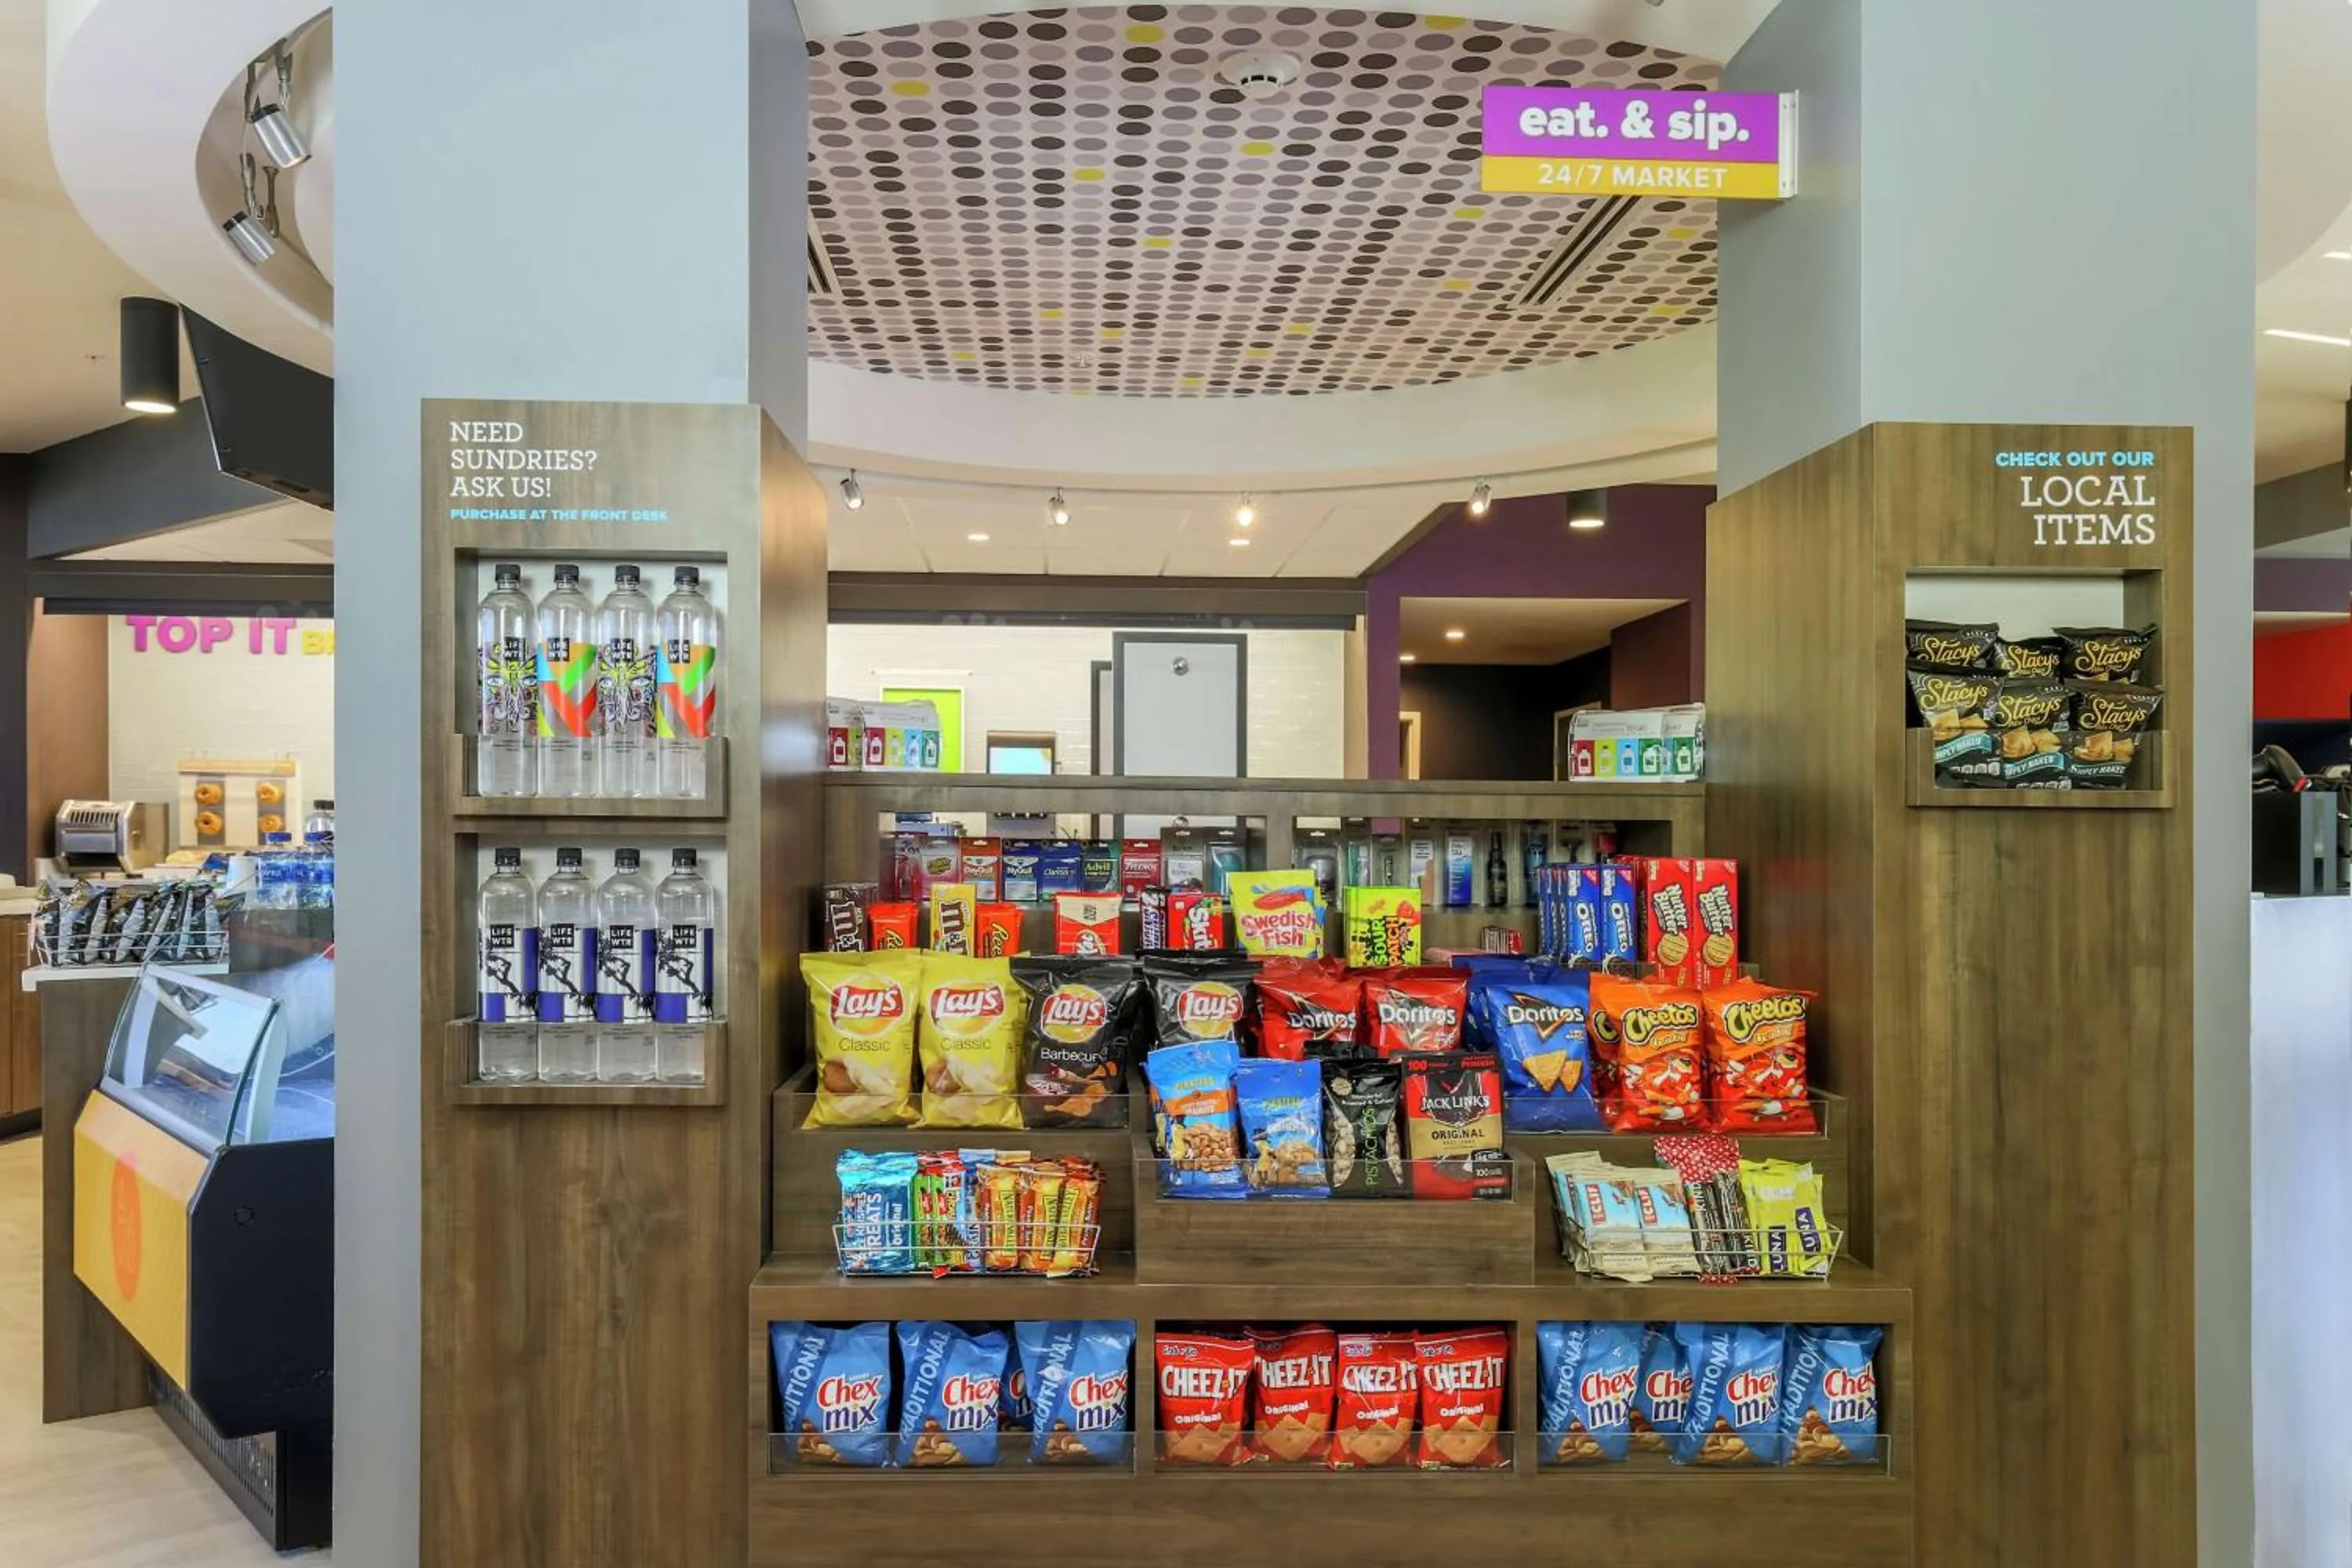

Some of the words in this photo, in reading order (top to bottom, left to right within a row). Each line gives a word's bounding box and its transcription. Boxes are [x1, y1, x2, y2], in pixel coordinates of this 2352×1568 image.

[1519, 101, 1609, 138] eat.
[1621, 100, 1655, 140] &
[1668, 100, 1750, 150] sip.
[1537, 163, 1603, 185] 24/7
[1612, 165, 1728, 189] MARKET
[449, 421, 524, 443] NEED
[449, 449, 598, 471] SUNDRIES?
[1995, 452, 2062, 467] CHECK
[2066, 452, 2107, 467] OUT
[2111, 452, 2155, 466] OUR
[449, 476, 505, 498] ASK
[510, 476, 552, 498] US!
[2020, 474, 2156, 507] LOCAL
[449, 509, 528, 521] PURCHASE
[529, 510, 547, 521] AT
[551, 510, 578, 521] THE
[581, 510, 628, 521] FRONT
[631, 510, 669, 522] DESK
[2033, 513, 2156, 545] ITEMS
[125, 615, 234, 654] TOP
[249, 616, 297, 655] IT
[2001, 644, 2060, 674] Stacy's
[2075, 641, 2143, 672] Stacy's
[1920, 677, 1989, 711] Stacy's
[1996, 693, 2061, 728] Stacy's
[2079, 695, 2147, 731] Stacy's
[1085, 862, 1111, 871] Advil
[1653, 891, 1678, 935] Butter
[1666, 884, 1688, 929] Nutter
[1699, 892, 1724, 935] Butter
[1711, 884, 1733, 931] Nutter
[492, 927, 512, 936] LIFE
[551, 927, 572, 936] LIFE
[611, 929, 632, 938] LIFE
[675, 927, 695, 936] LIFE
[1240, 910, 1318, 938] Swedish
[1261, 928, 1305, 950] Fish
[1576, 902, 1594, 953] OREO
[1610, 902, 1628, 953] OREO
[492, 937, 512, 946] WTR
[551, 936, 572, 946] WTR
[611, 938, 632, 947] WTR
[675, 937, 695, 946] WTR
[1371, 920, 1388, 965] SOUR
[1385, 916, 1402, 967] PATCH
[832, 985, 899, 1019] Lay's
[935, 986, 1000, 1018] Lay's
[1046, 994, 1103, 1026] Lay's
[1185, 992, 1240, 1022] Lay's
[1378, 1003, 1456, 1025] Doritos
[1507, 1005, 1584, 1023] Doritos
[1288, 1011, 1356, 1029] Doritos
[1623, 1004, 1697, 1044] Cheetos
[1725, 996, 1805, 1043] Cheetos
[838, 1036, 891, 1052] Classic
[941, 1036, 992, 1052] Classic
[1407, 1059, 1428, 1071] 100
[1421, 1097, 1451, 1111] JACK
[1431, 1128, 1486, 1141] ORIGINAL
[1586, 1185, 1602, 1213] CLIF
[1637, 1187, 1653, 1215] CLIF
[866, 1192, 882, 1257] TREATS
[1770, 1230, 1784, 1273] LUNA
[817, 1374, 883, 1409] Chex
[942, 1374, 1000, 1408] Chex
[1069, 1371, 1128, 1409] Chex
[1581, 1365, 1638, 1403] Chex
[1646, 1370, 1695, 1398] Che
[824, 1399, 879, 1432] mix
[947, 1399, 999, 1432] mix
[1076, 1399, 1127, 1431] mix
[1588, 1391, 1634, 1430] mix
[1652, 1397, 1687, 1423] mi
[1735, 1396, 1779, 1428] mix
[1829, 1396, 1878, 1423] mix
